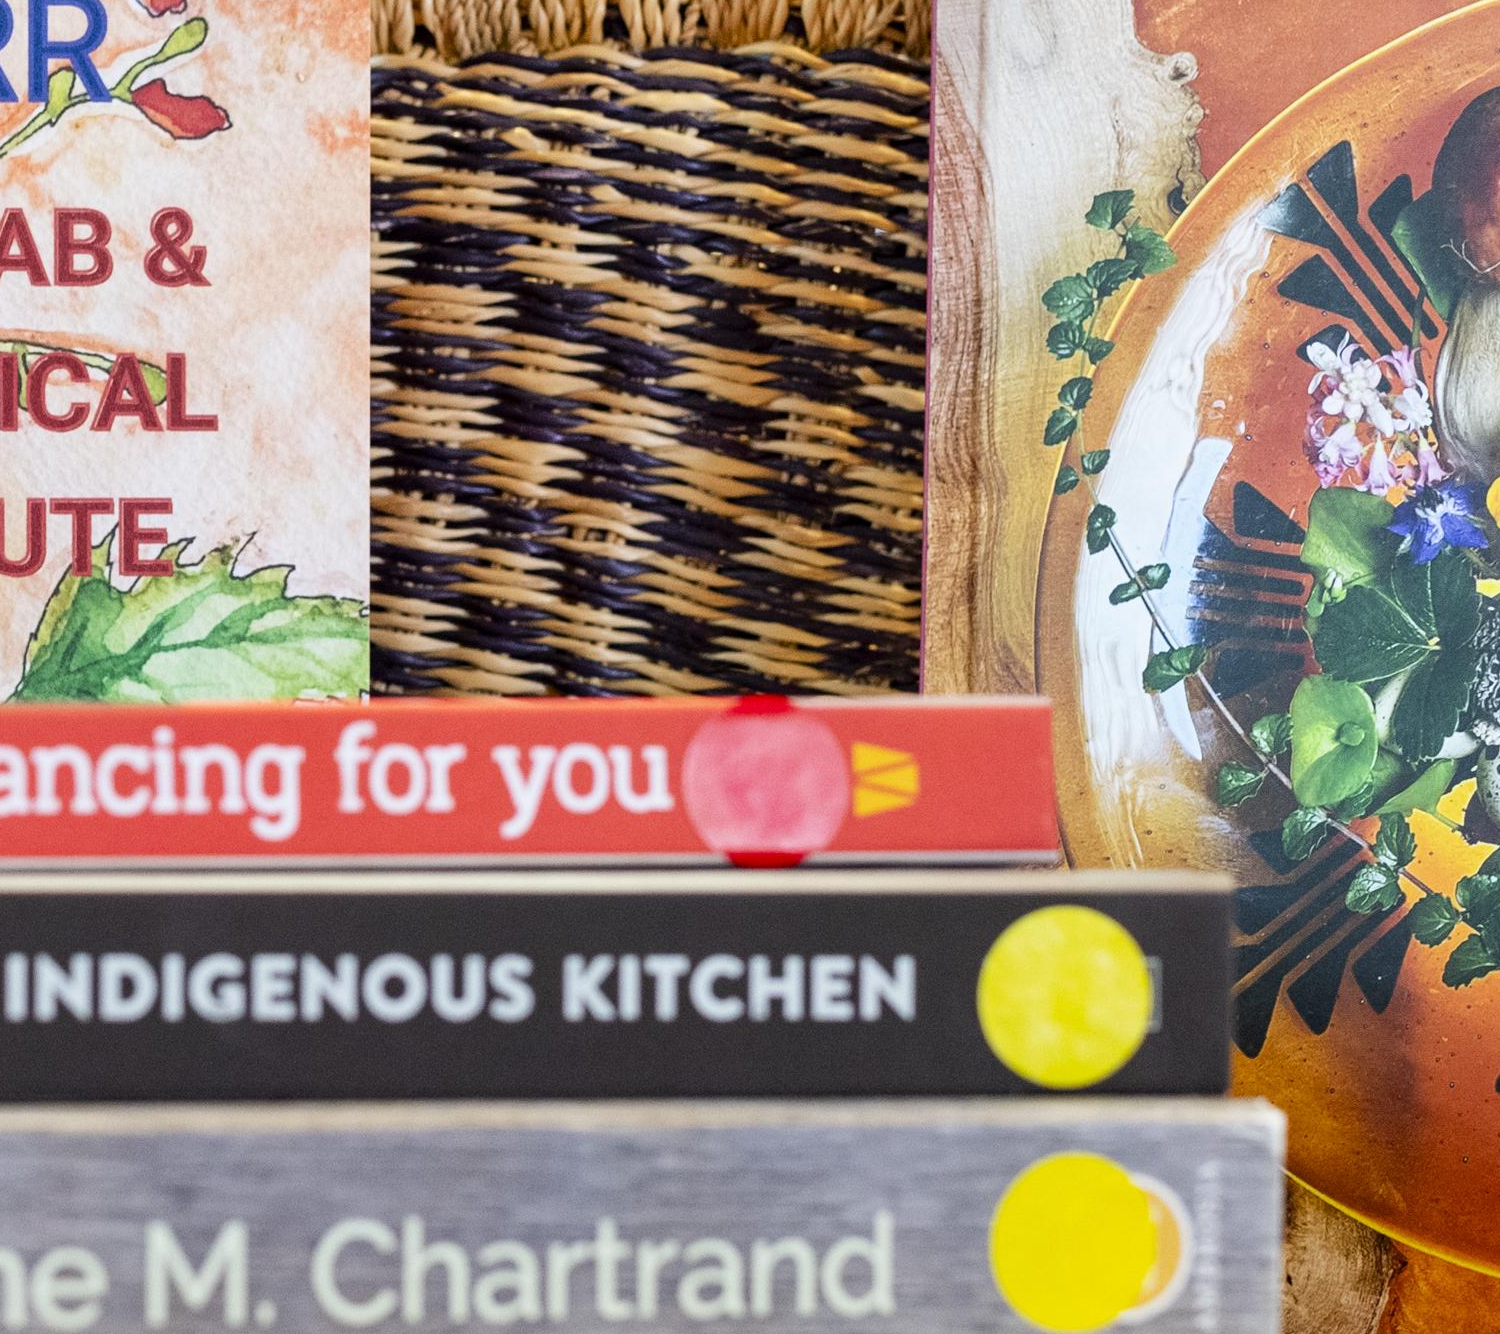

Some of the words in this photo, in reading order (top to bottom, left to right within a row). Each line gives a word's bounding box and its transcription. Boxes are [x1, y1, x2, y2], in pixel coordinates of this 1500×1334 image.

[142, 207, 209, 289] &
[333, 721, 466, 816] for
[492, 742, 676, 838] you
[3, 952, 534, 1024] INDIGENOUS
[562, 953, 917, 1023] KITCHEN
[143, 1218, 278, 1328] M.
[311, 1210, 896, 1324] Chartrand
